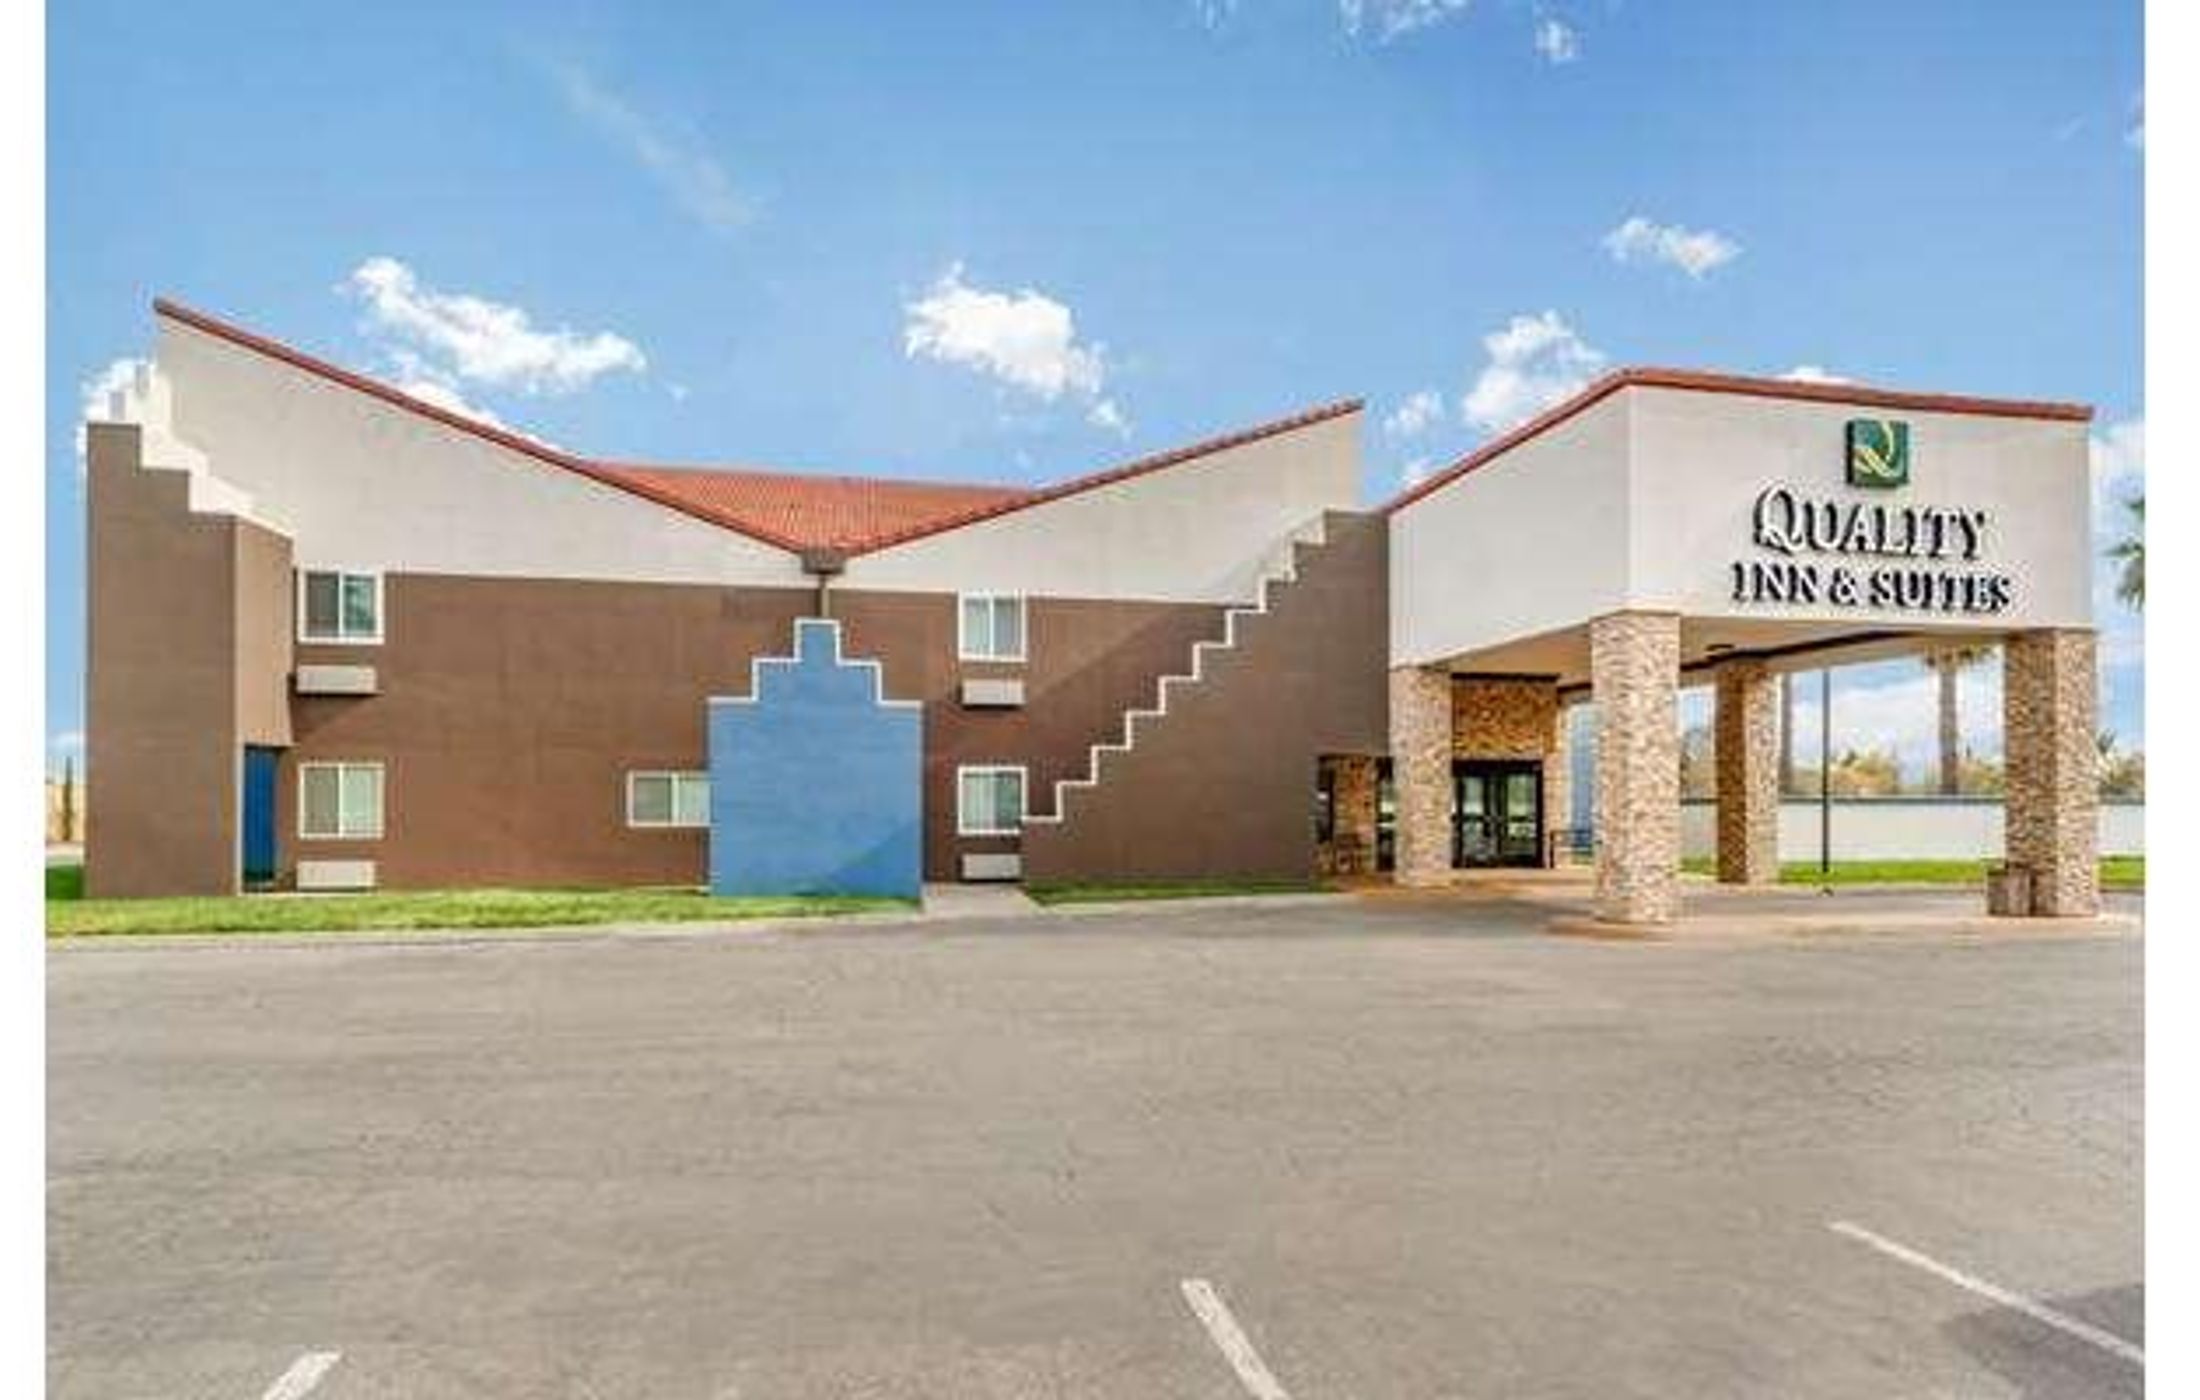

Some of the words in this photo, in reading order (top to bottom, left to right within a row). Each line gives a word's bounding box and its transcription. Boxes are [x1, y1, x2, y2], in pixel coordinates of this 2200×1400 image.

[1753, 485, 1986, 559] QUALITY
[1732, 562, 1818, 603] INN
[1829, 570, 1857, 607] &
[1868, 570, 2011, 612] SUITES
